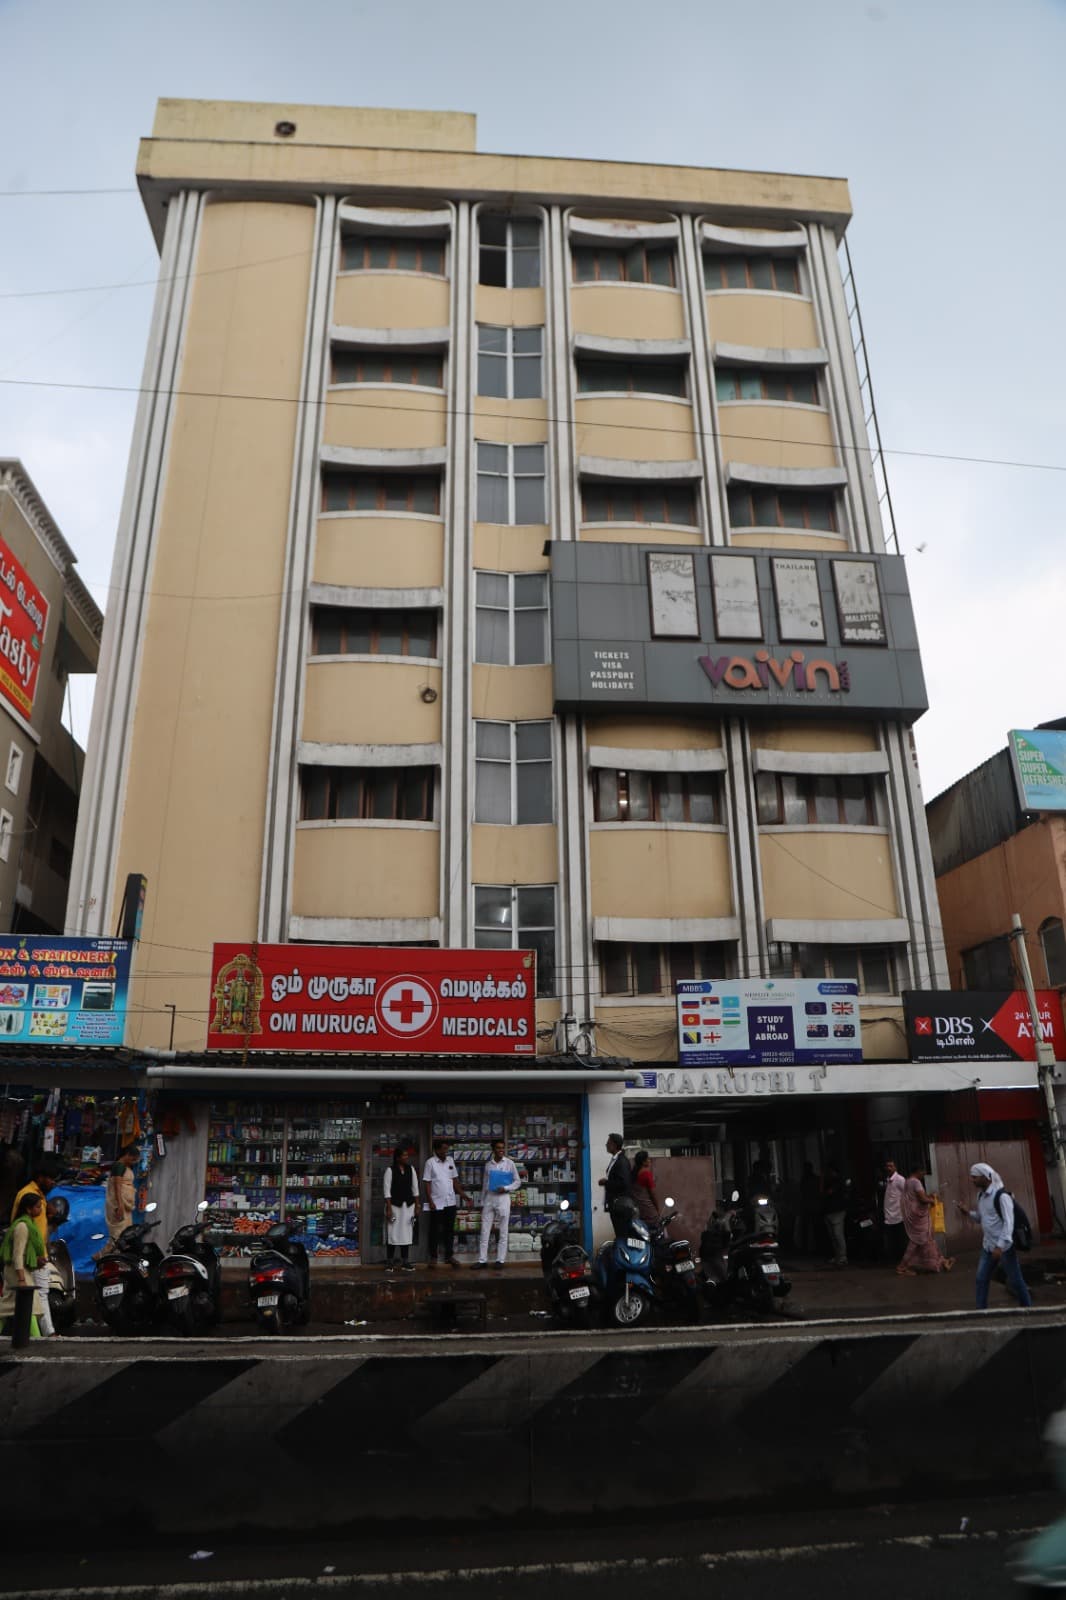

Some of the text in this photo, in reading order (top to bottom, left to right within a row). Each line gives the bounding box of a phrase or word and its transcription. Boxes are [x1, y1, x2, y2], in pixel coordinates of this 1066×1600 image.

[594, 651, 630, 659] TICKETS
[590, 671, 634, 679] PASSPORT
[592, 681, 634, 689] HOLIDAYS
[1018, 751, 1045, 762] SUPER
[18, 948, 30, 960] &
[32, 949, 118, 963] STATIONERY
[28, 965, 41, 977] &
[271, 968, 527, 1003] ஓம் முருகா மெடிக்கல்
[682, 985, 704, 993] MBBS
[757, 1015, 784, 1024] STUDY
[1014, 1011, 1051, 1020] 24 HUR
[269, 1013, 528, 1036] OM MURUGA MEDICALS
[766, 1024, 776, 1032] IN
[935, 1016, 974, 1035] DBS
[755, 1032, 789, 1041] ABROAD
[656, 1071, 797, 1095] MAARUTHI
